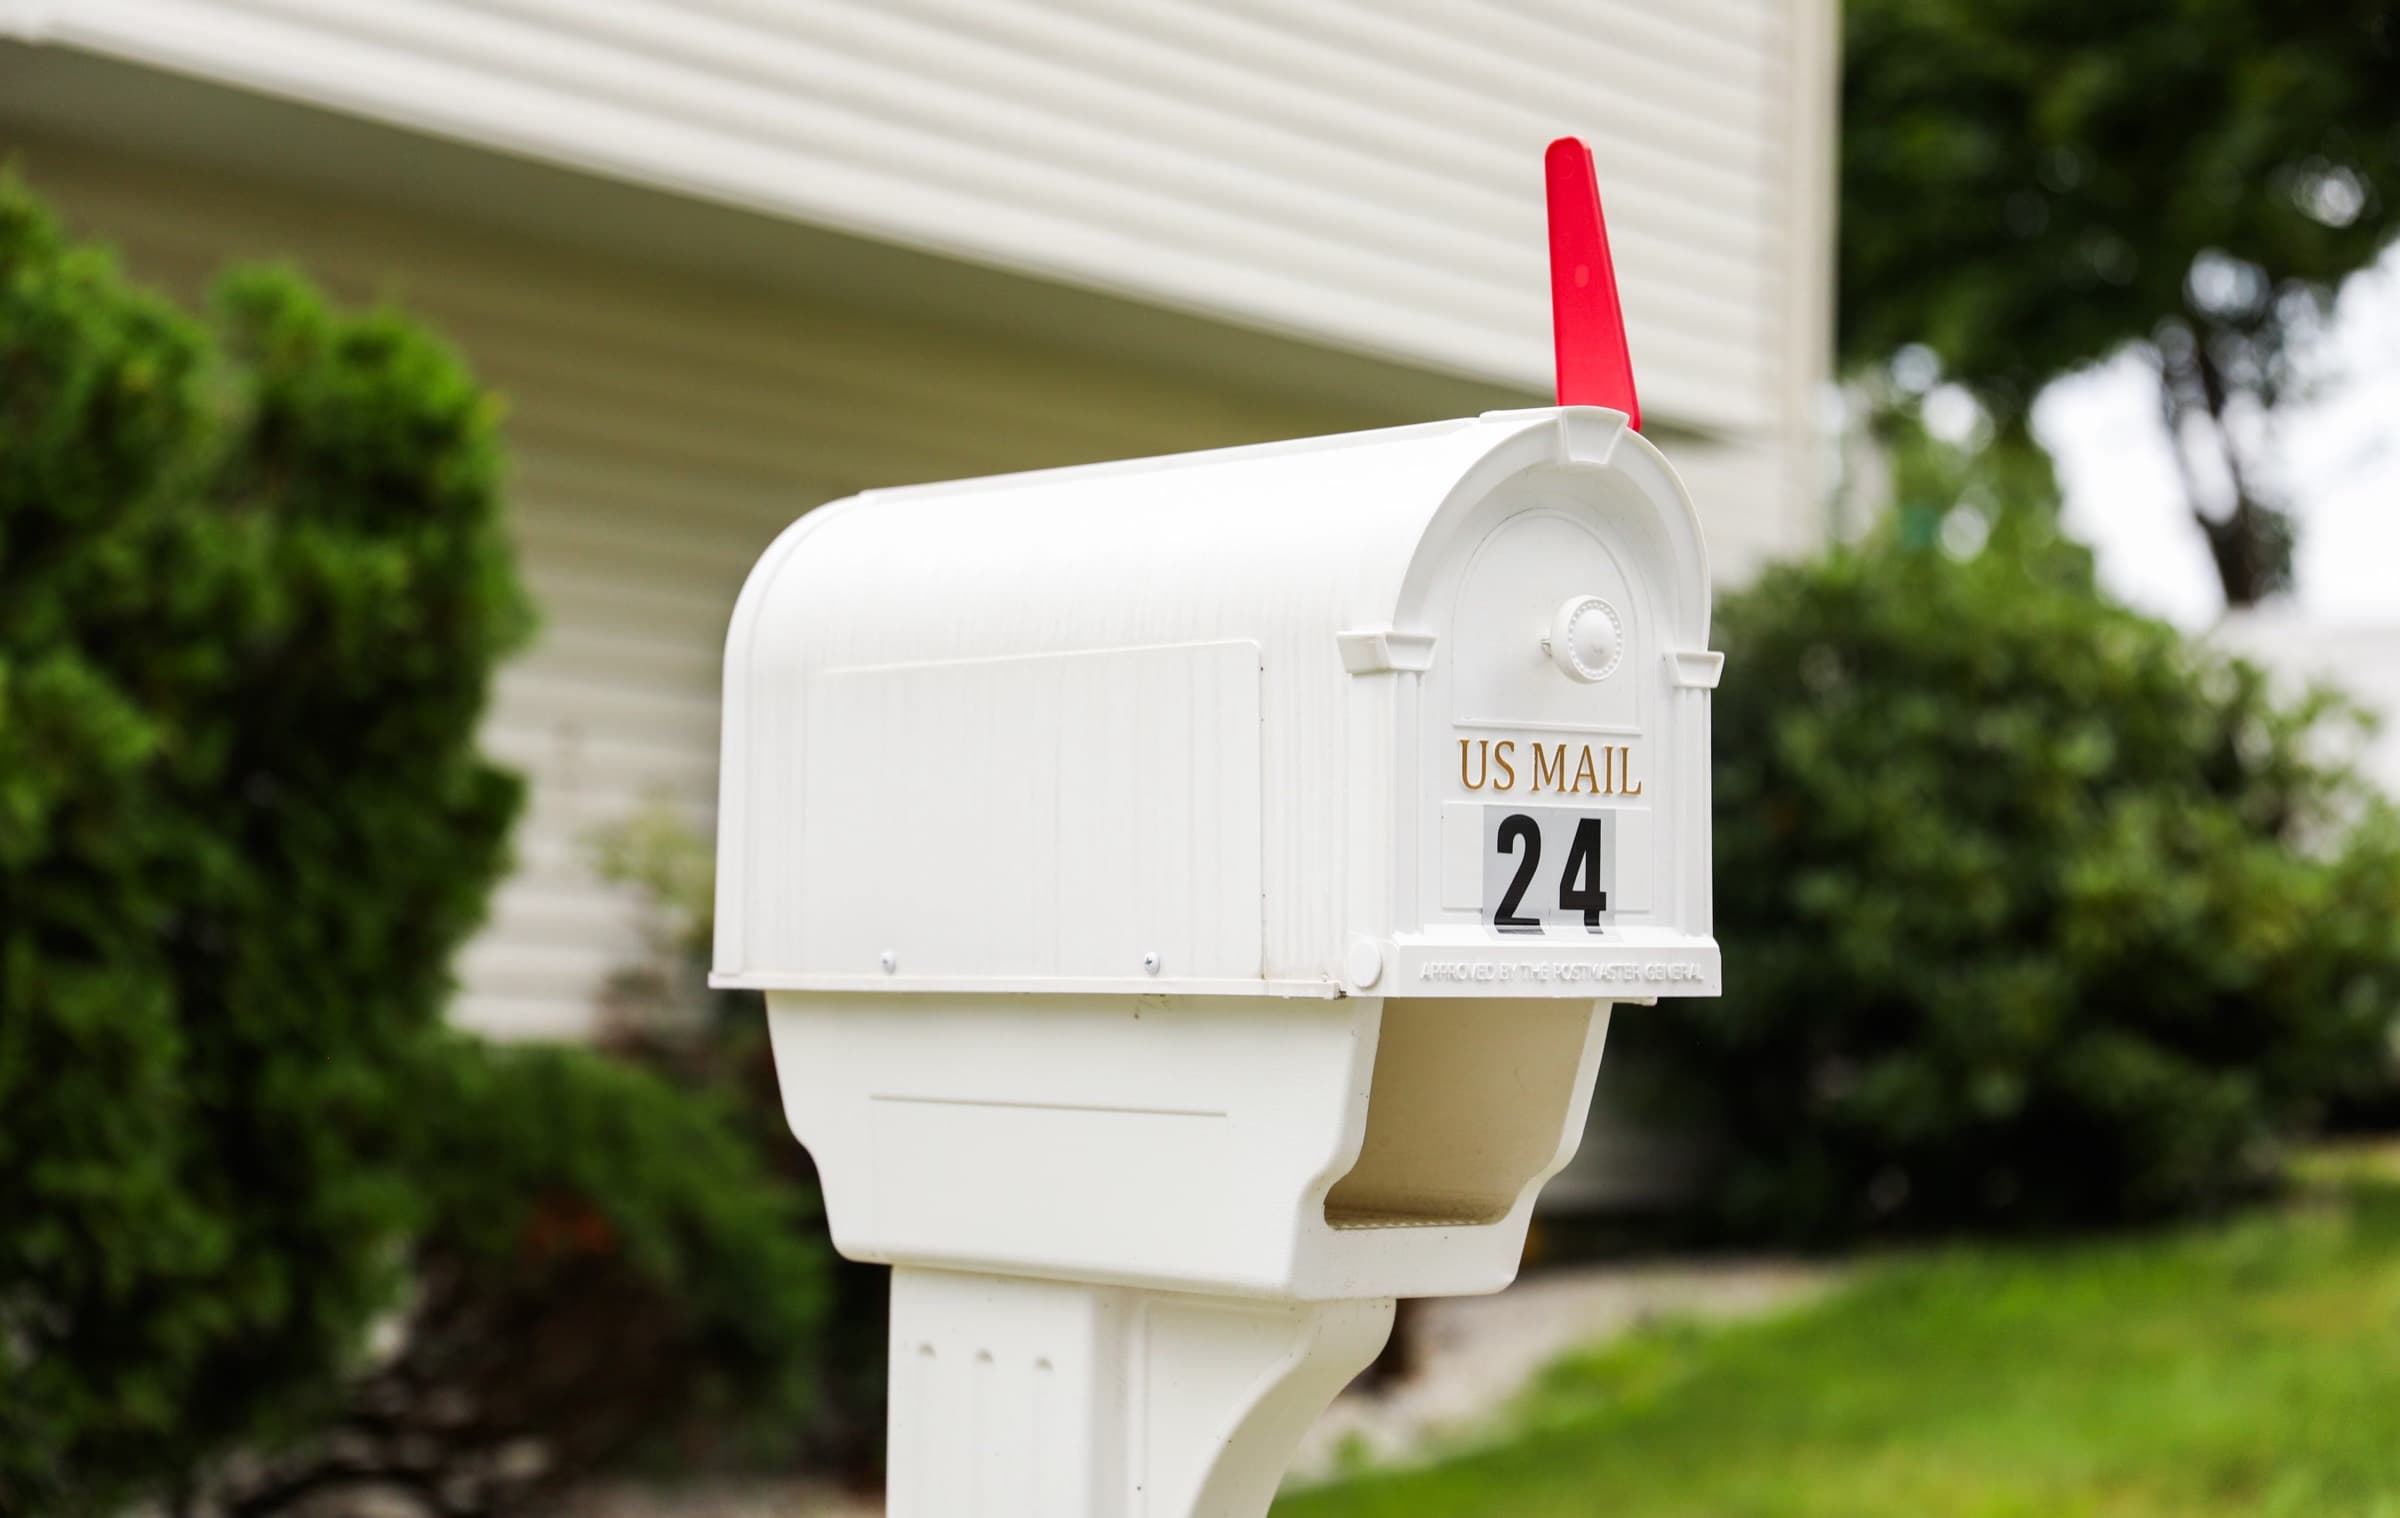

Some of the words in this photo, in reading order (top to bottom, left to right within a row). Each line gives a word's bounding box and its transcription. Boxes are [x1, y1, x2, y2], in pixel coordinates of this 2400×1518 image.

[1458, 738, 1515, 791] US
[1531, 742, 1642, 796] MAIL
[1493, 813, 1607, 935] 24
[1420, 961, 1494, 982] APPROVED
[1499, 961, 1517, 982] BY
[1519, 961, 1550, 982] THE
[1552, 961, 1641, 982] POSTMASTER
[1646, 962, 1704, 983] GENERAL
